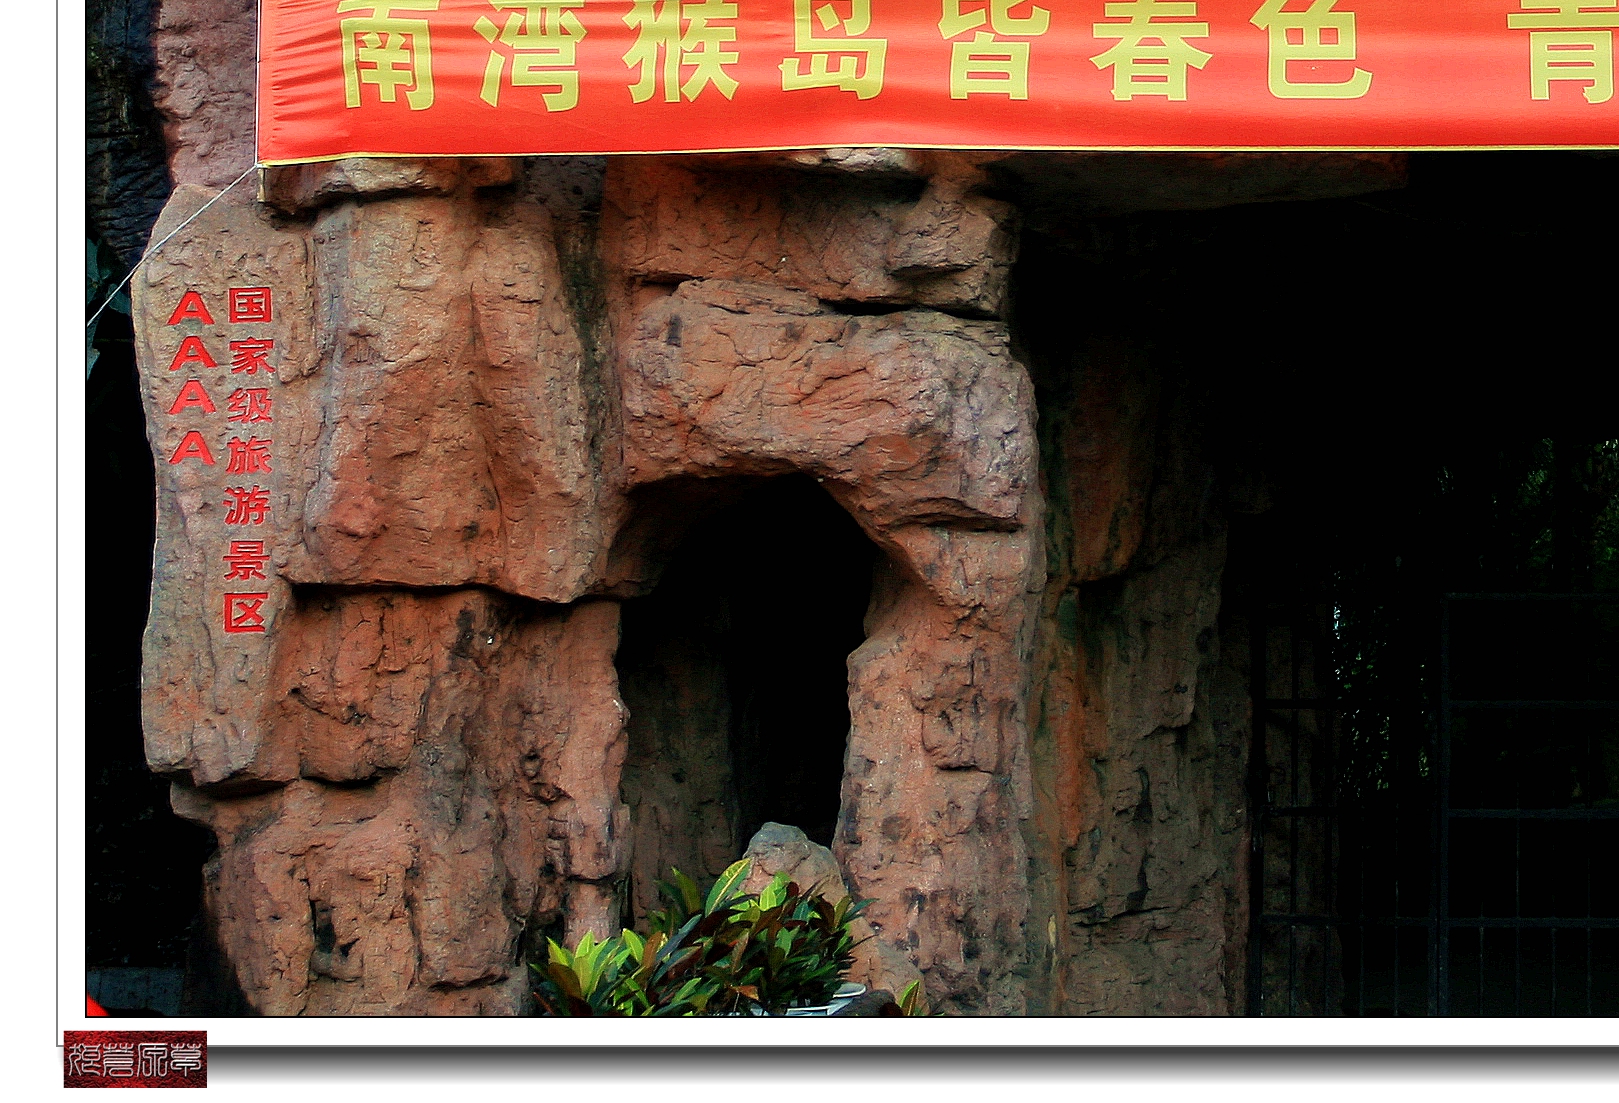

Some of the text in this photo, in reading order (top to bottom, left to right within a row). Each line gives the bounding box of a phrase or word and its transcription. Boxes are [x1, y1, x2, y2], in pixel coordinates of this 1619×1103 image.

[222, 286, 276, 633] 国家级旅游景区
